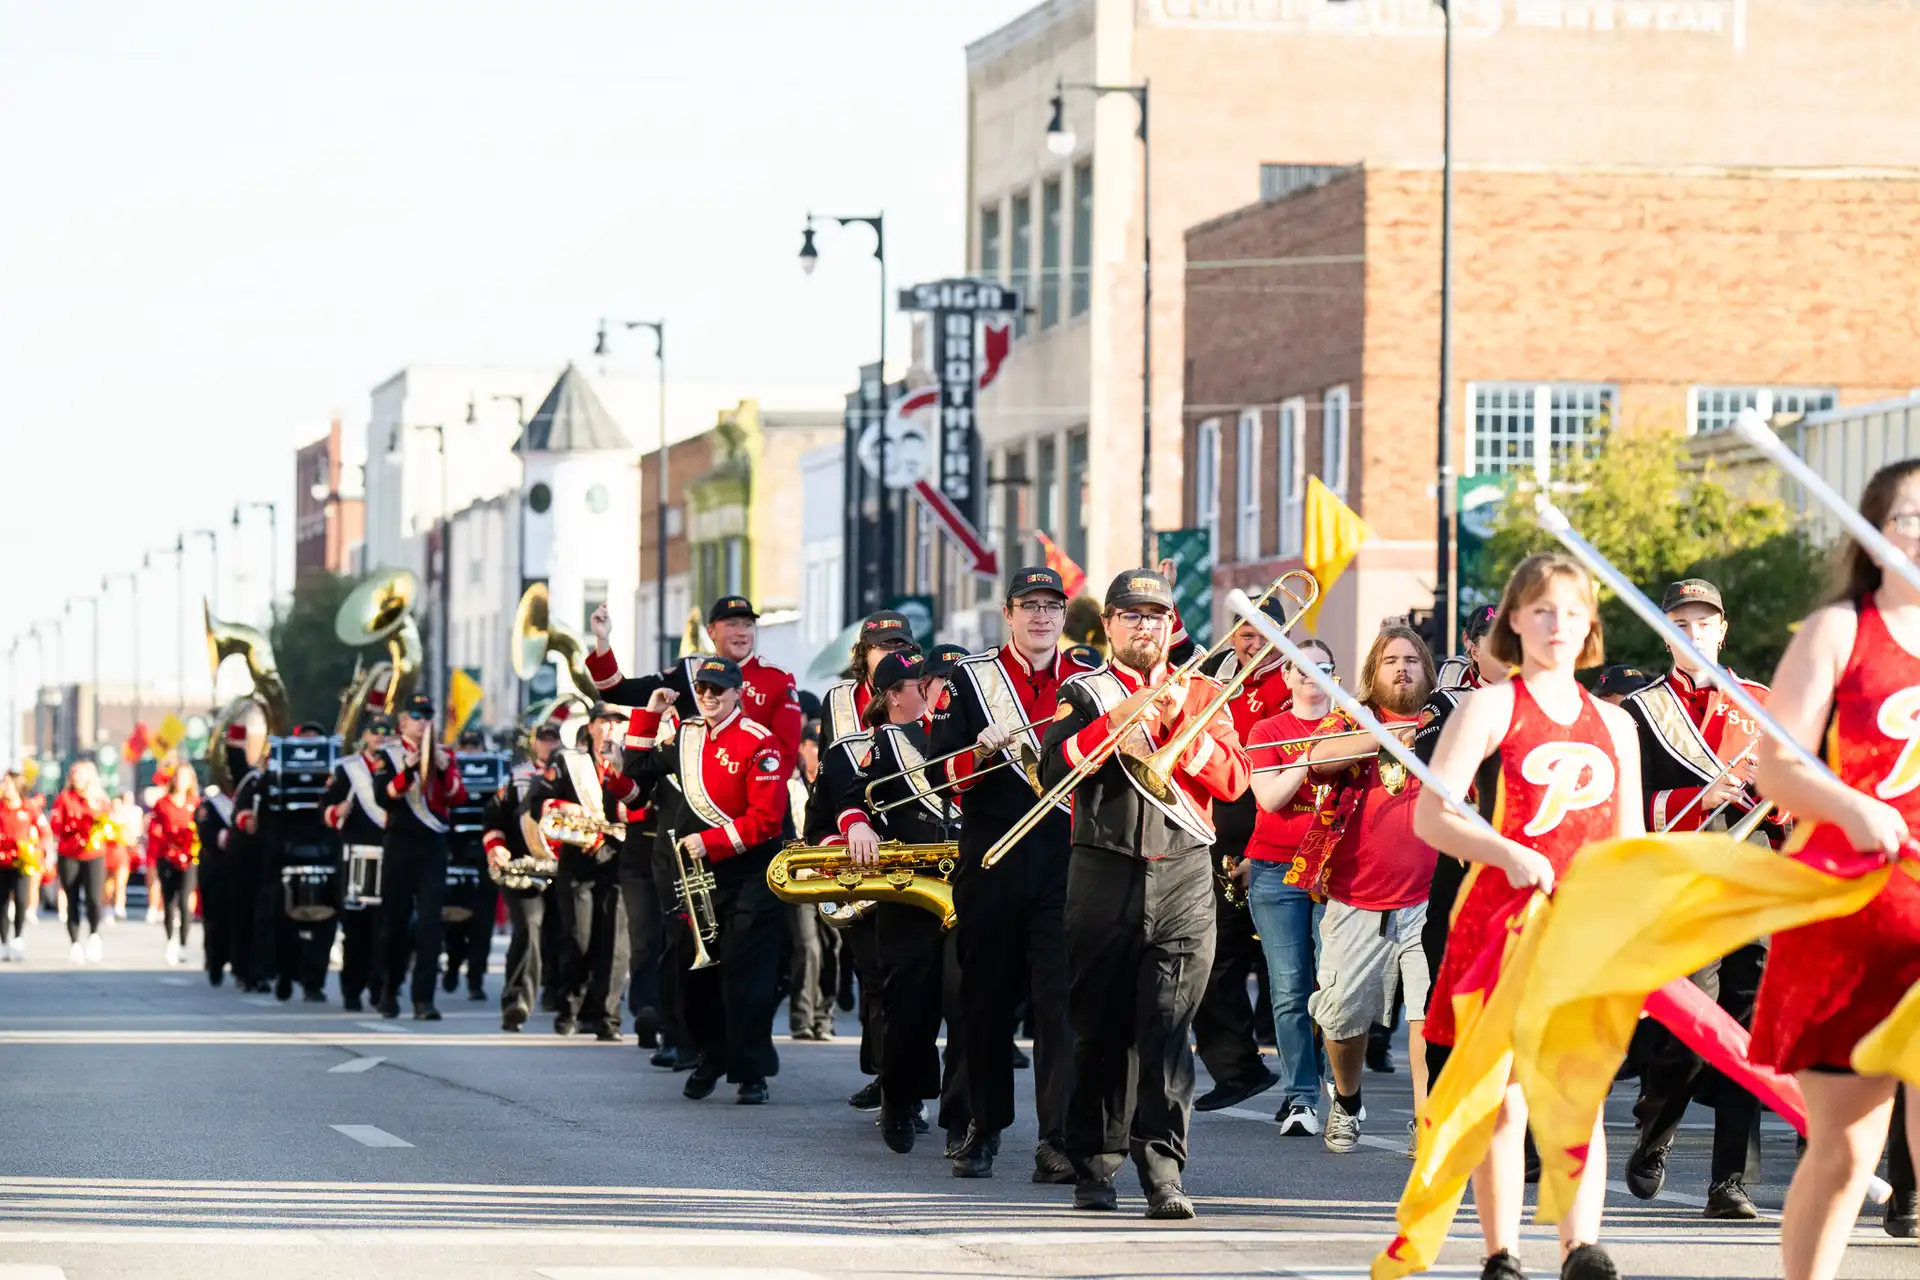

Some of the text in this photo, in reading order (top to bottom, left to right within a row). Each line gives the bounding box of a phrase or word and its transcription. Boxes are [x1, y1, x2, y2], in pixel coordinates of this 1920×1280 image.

[944, 313, 971, 499] BROTHERS
[741, 680, 767, 706] PSU
[1716, 703, 1756, 734] PSU
[714, 747, 740, 775] PSU
[1521, 741, 1616, 837] P
